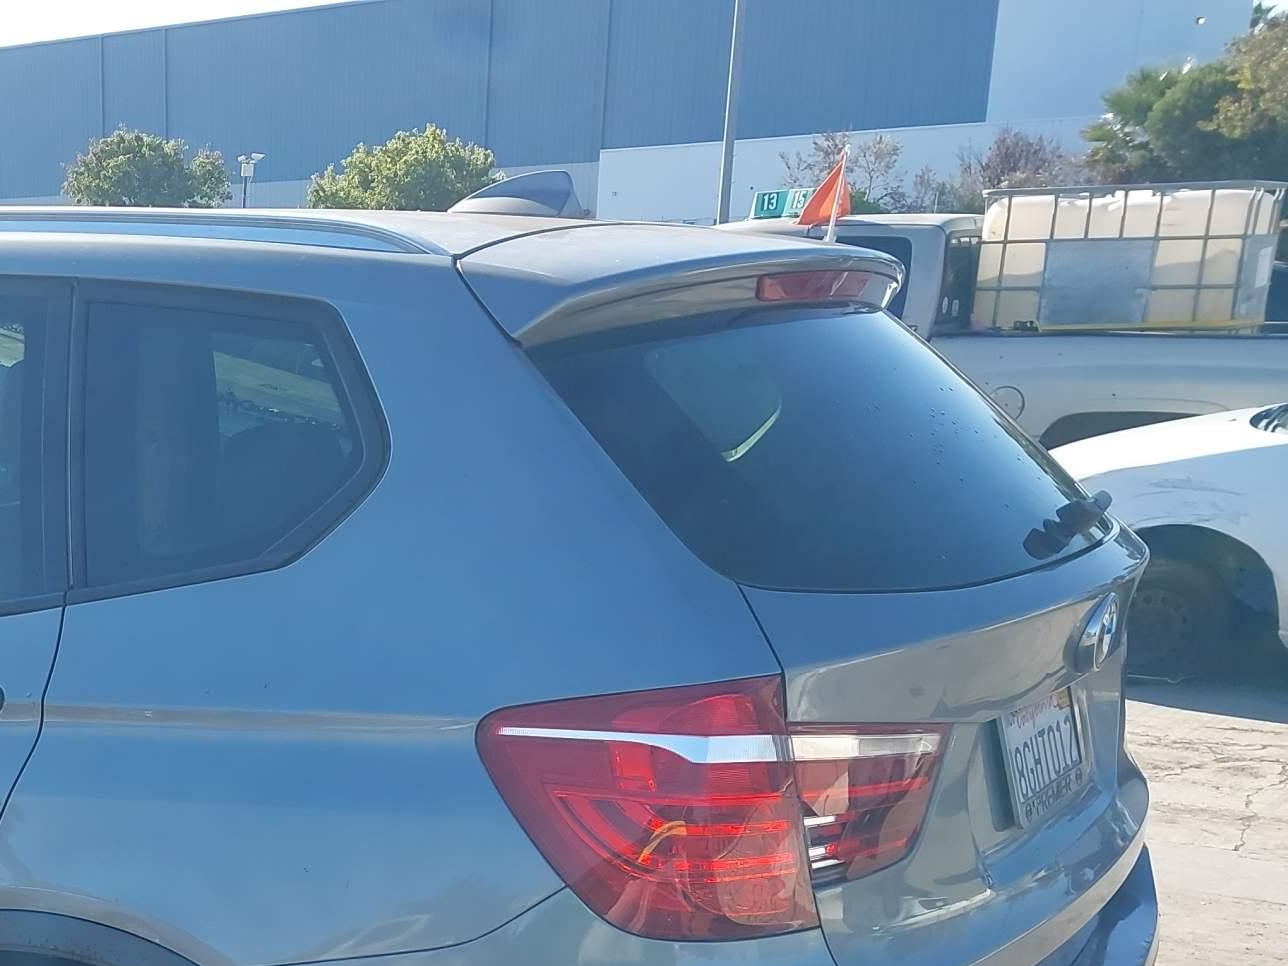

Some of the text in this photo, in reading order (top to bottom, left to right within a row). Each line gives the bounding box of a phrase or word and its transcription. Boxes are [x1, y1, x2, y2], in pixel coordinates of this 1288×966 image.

[763, 193, 777, 210] 13
[792, 191, 806, 208] 15
[1014, 714, 1078, 801] 8GHT012
